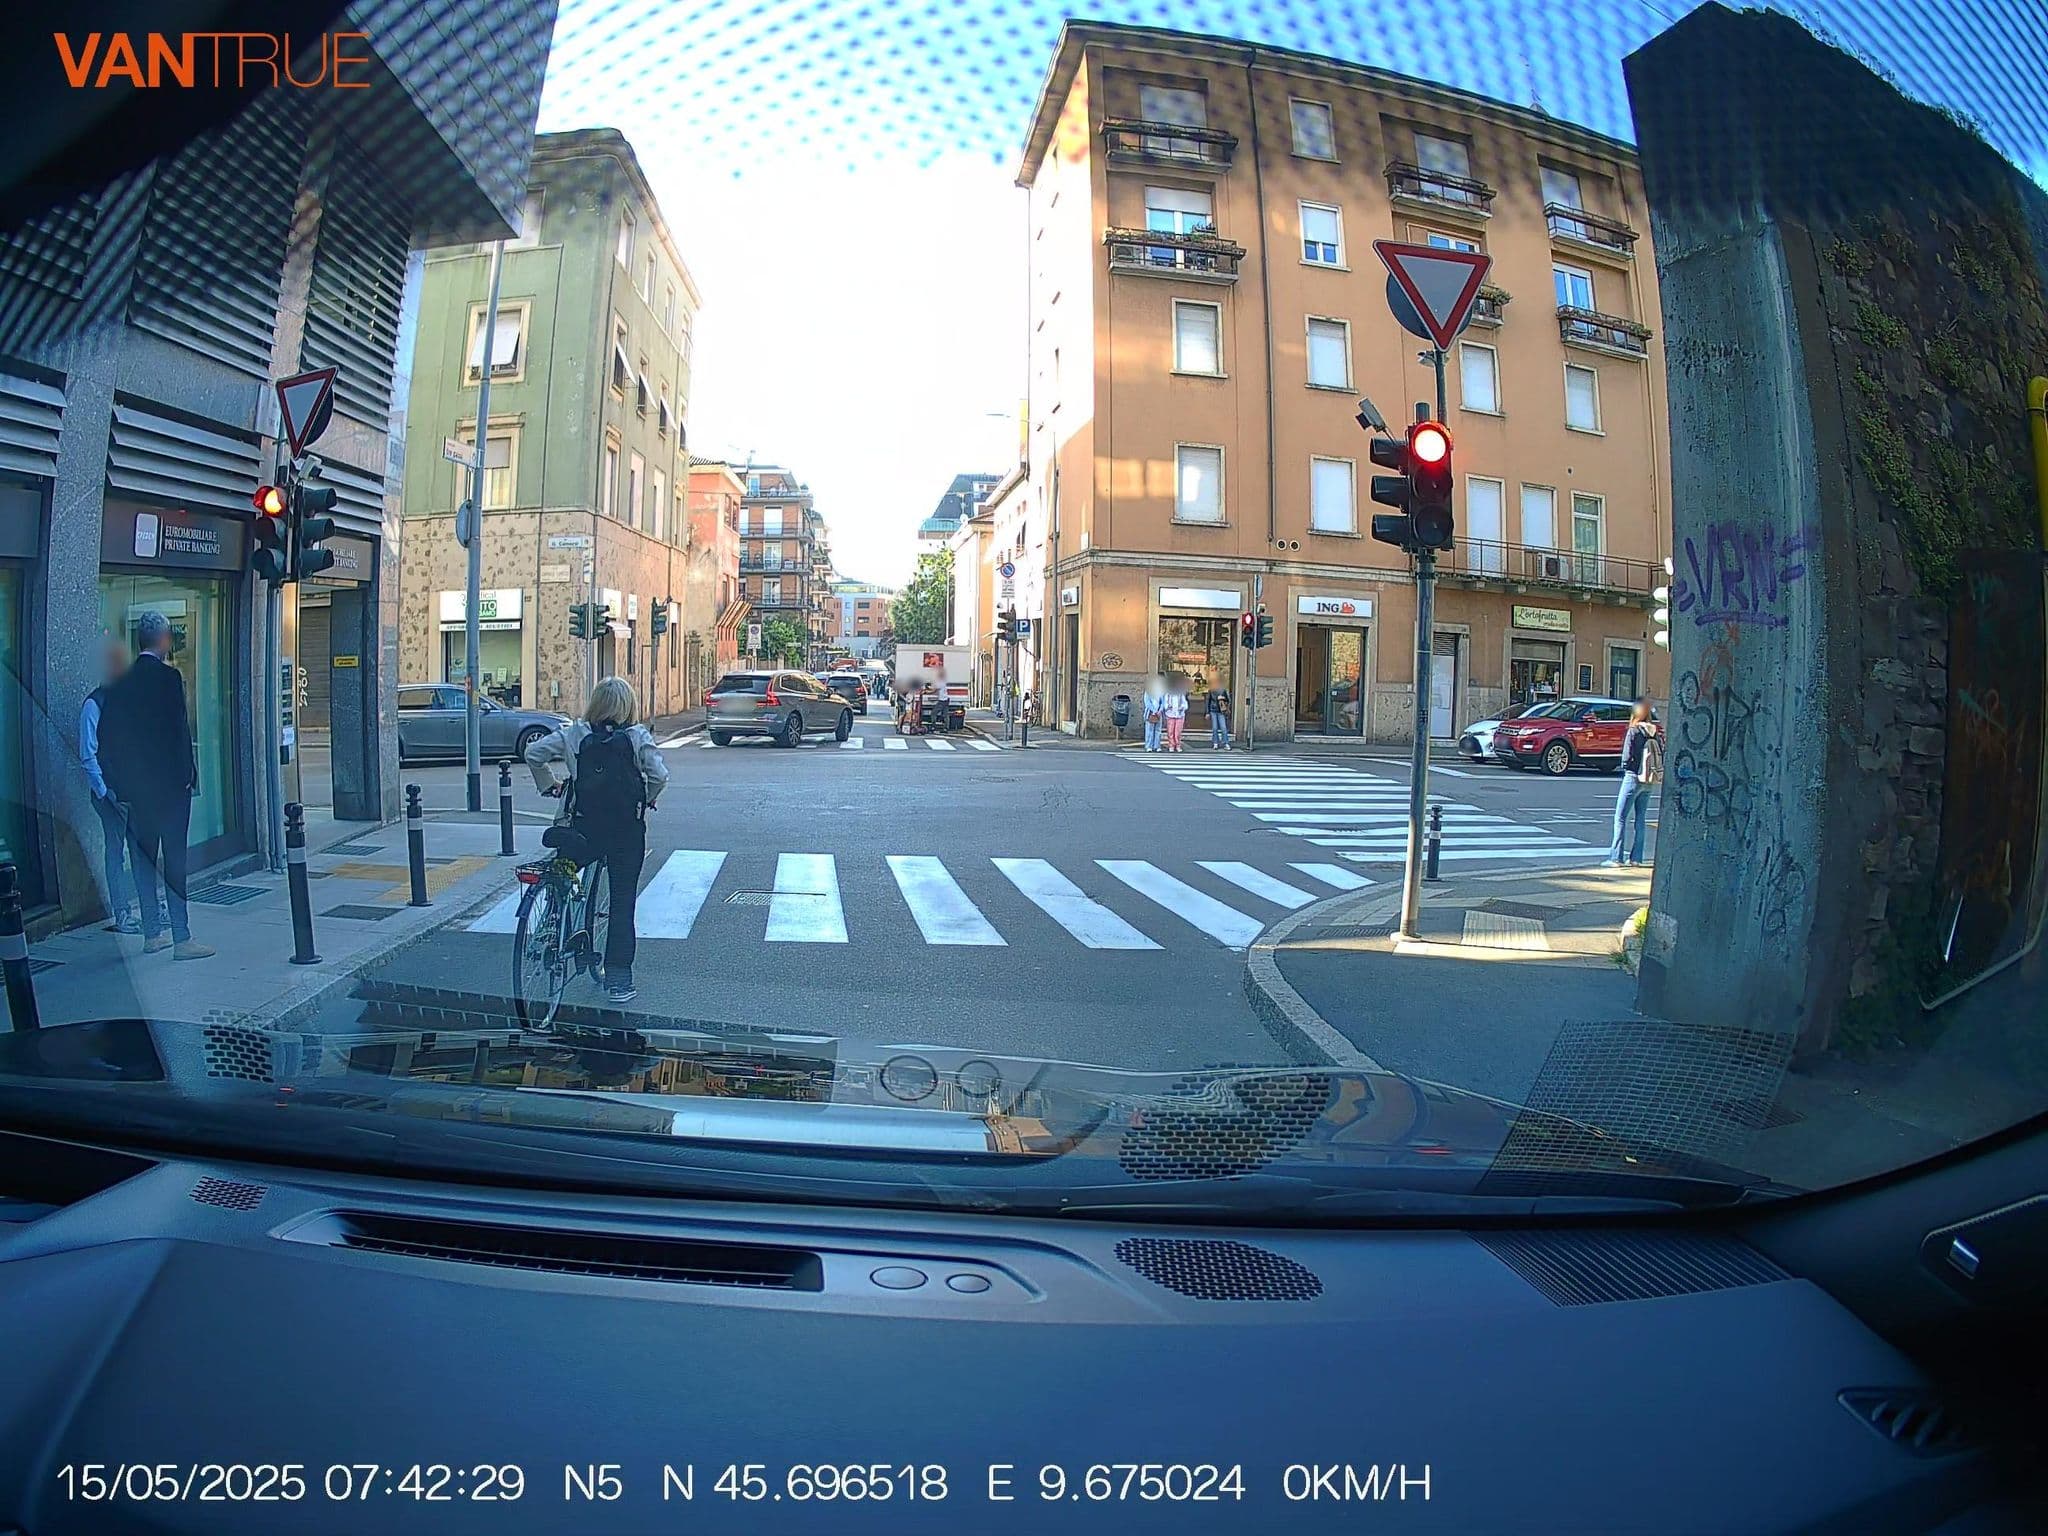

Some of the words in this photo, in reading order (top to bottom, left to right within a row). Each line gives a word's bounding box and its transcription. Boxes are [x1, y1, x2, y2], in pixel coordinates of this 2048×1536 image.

[165, 525, 217, 542] EUROMOBILIARE
[164, 538, 191, 552] PRIVATE
[191, 541, 220, 554] BANKING
[1317, 602, 1340, 613] ING
[1019, 620, 1028, 631] P
